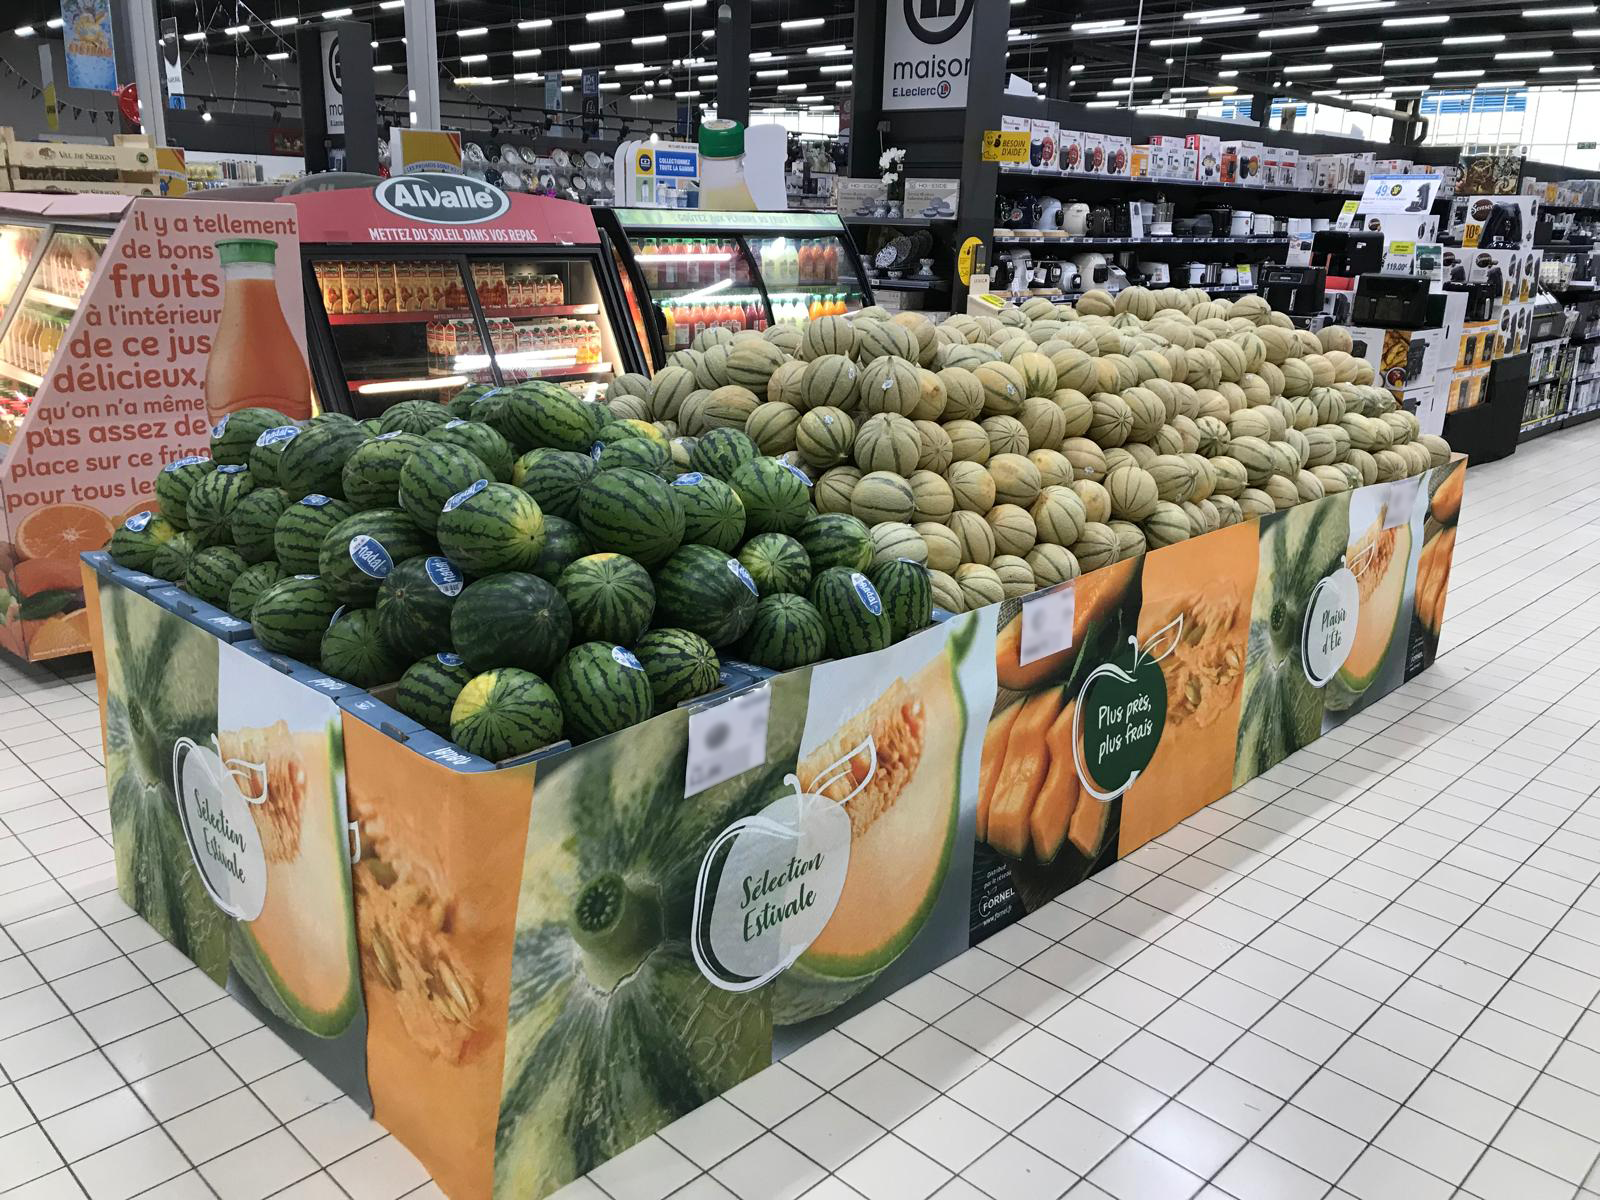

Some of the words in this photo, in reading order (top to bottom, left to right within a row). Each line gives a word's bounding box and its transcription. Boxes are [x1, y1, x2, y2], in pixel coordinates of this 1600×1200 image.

[892, 86, 936, 98] E.Leclerc
[58, 152, 74, 160] VAL
[1002, 148, 1022, 156] D'AIDE
[394, 184, 494, 208] Alvalle
[134, 212, 148, 232] il
[155, 216, 168, 236] y
[174, 216, 189, 232] a
[194, 214, 296, 236] tellement
[368, 228, 412, 241] METTEZ
[412, 228, 428, 241] DU
[428, 228, 464, 241] SOLEIL
[464, 229, 489, 241] DANS
[490, 229, 508, 241] VOS
[509, 229, 538, 241] REPAS
[122, 240, 151, 260] de
[158, 240, 214, 260] bons
[109, 263, 220, 299] fruits
[86, 304, 102, 328] à
[108, 304, 222, 326] l'intérieur
[70, 331, 113, 359] de
[122, 335, 160, 356] ce
[167, 328, 212, 362] jus
[54, 364, 206, 394] délicieux,
[38, 402, 99, 424] qu'on
[106, 398, 138, 416] n'a
[144, 394, 204, 414] même
[88, 422, 168, 444] assez
[174, 414, 208, 436] de
[11, 458, 79, 484] place
[86, 455, 122, 472] sur
[128, 451, 154, 468] ce
[6, 490, 66, 513] pour
[72, 482, 126, 502] tous
[358, 546, 386, 572] nadal
[1322, 608, 1346, 632] Plaisir
[1098, 706, 1124, 730] Plus
[1126, 693, 1152, 724] près,
[1098, 734, 1122, 764] plus
[1125, 718, 1154, 744] frais
[194, 788, 246, 852] Sélection
[203, 827, 246, 884] Estivale
[740, 852, 824, 909] Sélection
[744, 882, 816, 942] Estivale
[983, 888, 1016, 912] FORNEL
